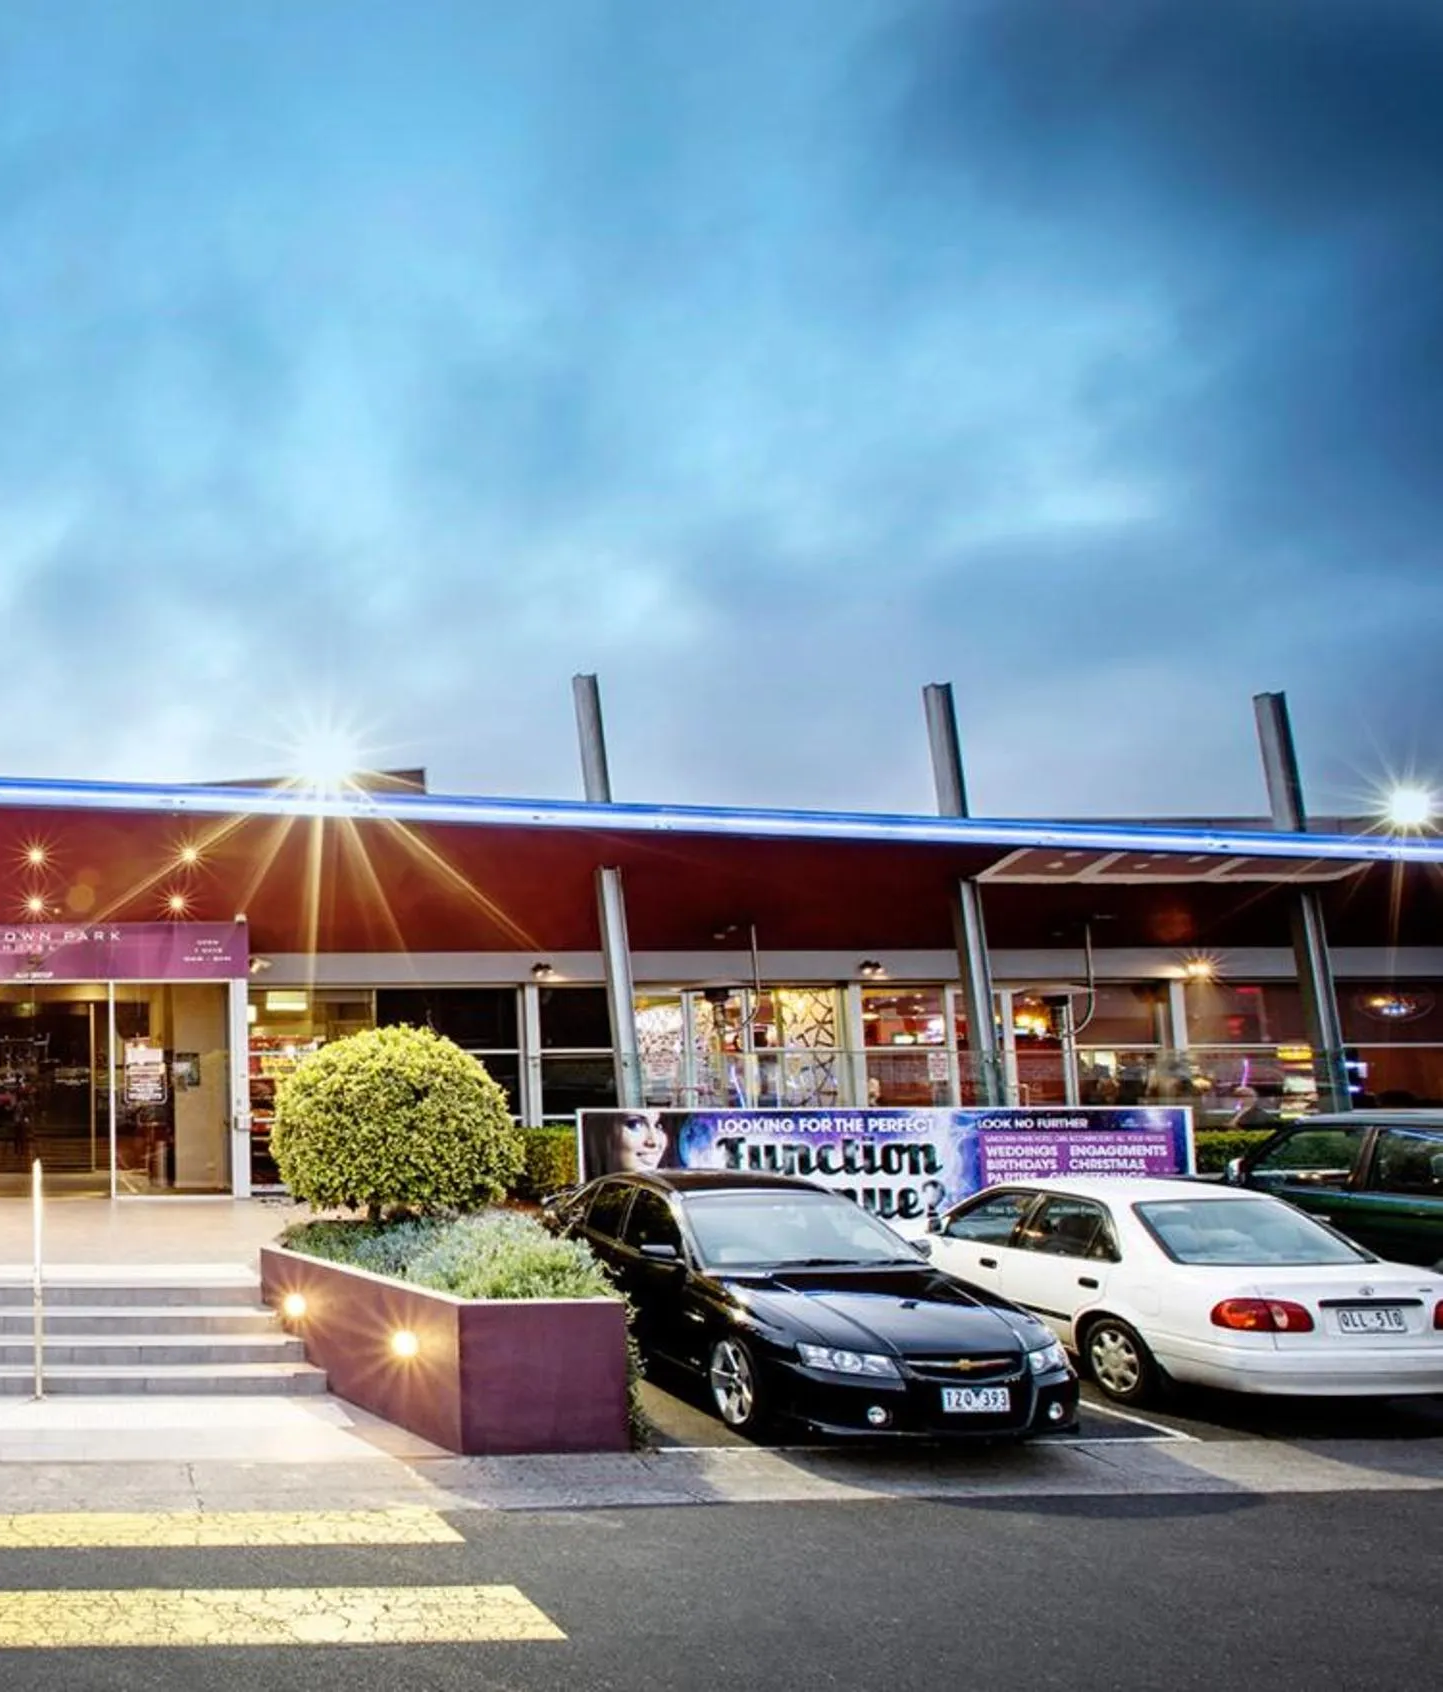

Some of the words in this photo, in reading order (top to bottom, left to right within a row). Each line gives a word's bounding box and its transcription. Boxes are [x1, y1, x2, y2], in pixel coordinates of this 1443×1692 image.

[64, 931, 121, 942] PARK
[717, 1118, 794, 1134] LOOKING
[799, 1118, 832, 1133] FOR
[833, 1118, 865, 1133] THE
[867, 1117, 934, 1133] PERFECT
[978, 1118, 1012, 1129] LOOK
[1014, 1118, 1034, 1129] NO
[1037, 1117, 1088, 1129] FURTHER
[716, 1136, 943, 1176] Function
[985, 1145, 1058, 1157] WEDDINGS
[1069, 1145, 1168, 1157] ENGAGEMENTS
[986, 1158, 1058, 1170] BIRTHDAYS
[1069, 1158, 1148, 1171] CHRISTMAS
